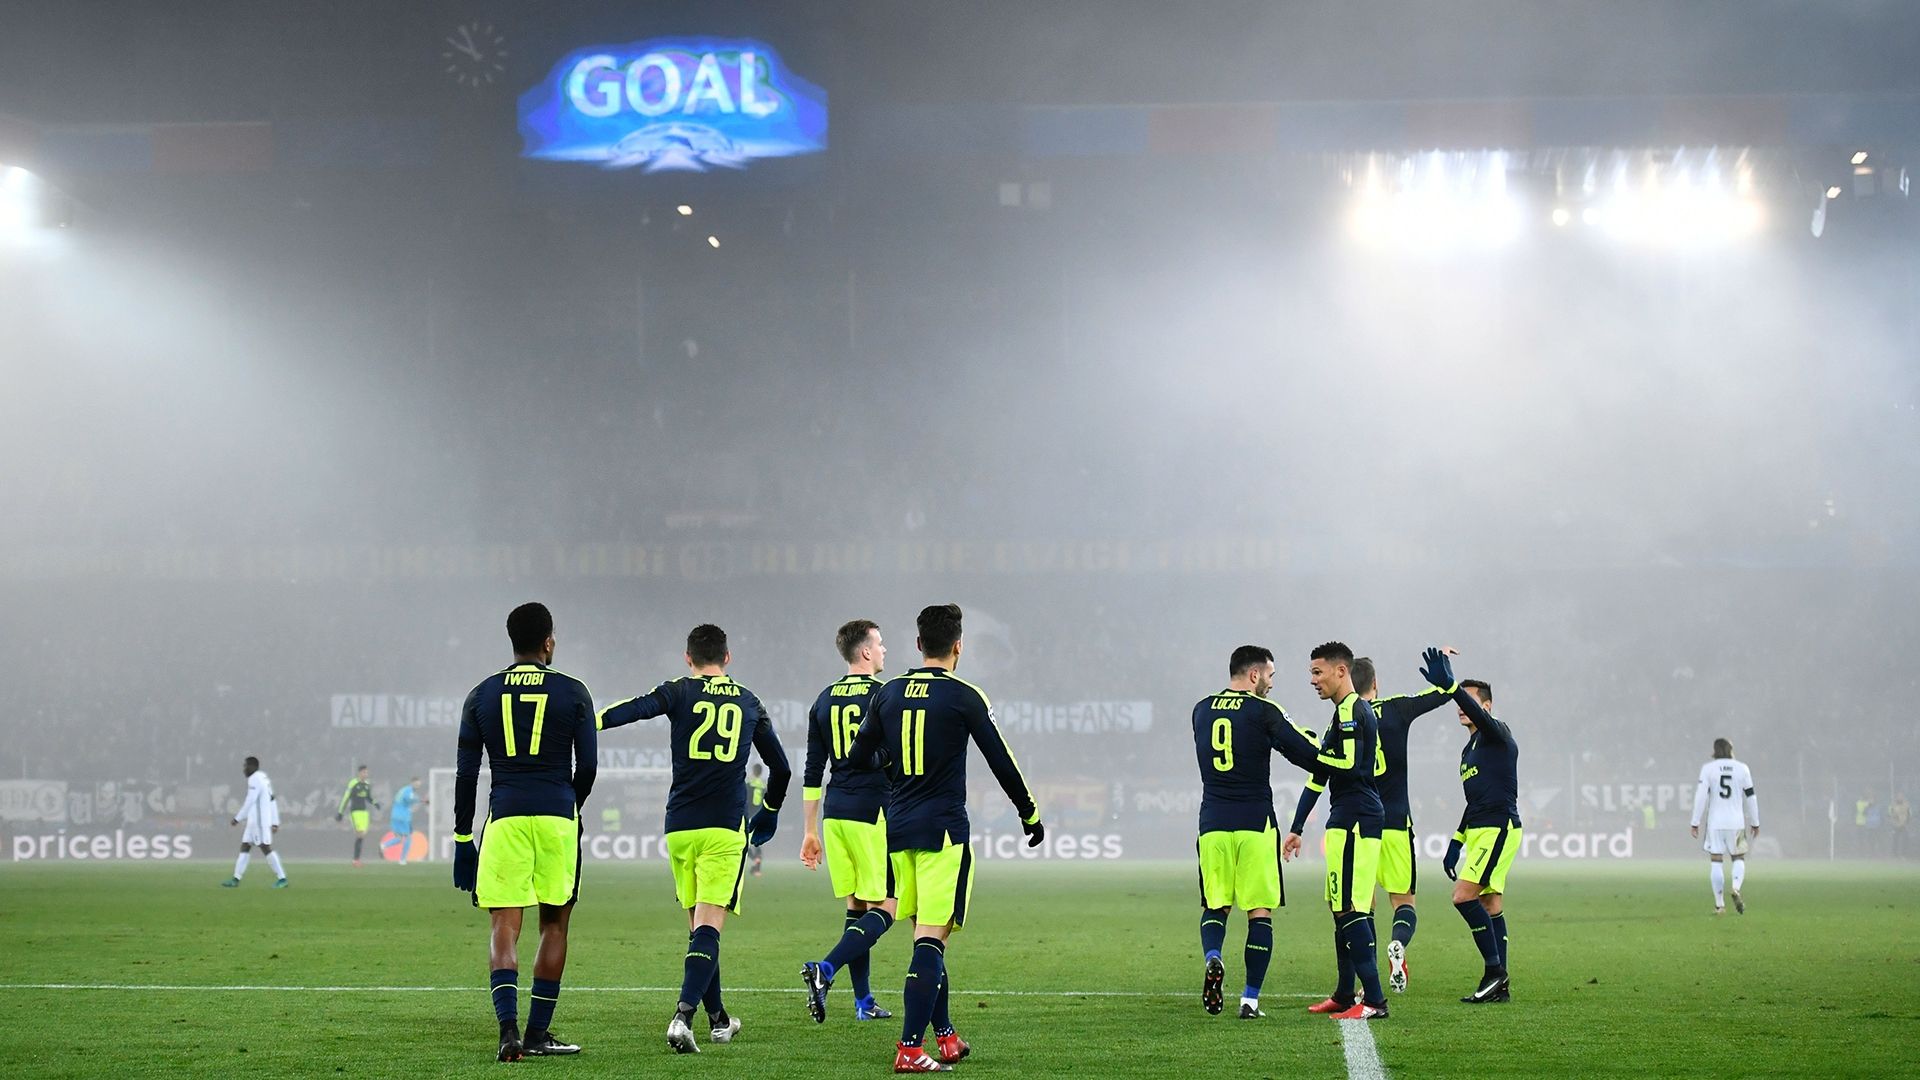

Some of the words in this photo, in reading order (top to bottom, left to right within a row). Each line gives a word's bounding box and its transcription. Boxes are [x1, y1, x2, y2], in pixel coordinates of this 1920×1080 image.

[569, 53, 778, 117] GOAL
[504, 673, 545, 686] IWOBI
[702, 682, 741, 697] XHAKA
[830, 683, 871, 697] HOLDING
[904, 680, 930, 698] ÖZIL
[1211, 697, 1243, 711] LUCAS
[501, 693, 548, 757] 17
[689, 701, 743, 762] 29
[830, 704, 863, 760] 16
[901, 709, 926, 776] 11
[1211, 717, 1234, 772] 9
[1581, 784, 1693, 812] SLEEPE
[1719, 775, 1732, 799] 5
[13, 828, 192, 861] priceless
[970, 828, 1124, 859] riceless
[1474, 847, 1488, 866] 7
[1330, 871, 1338, 895] 3
